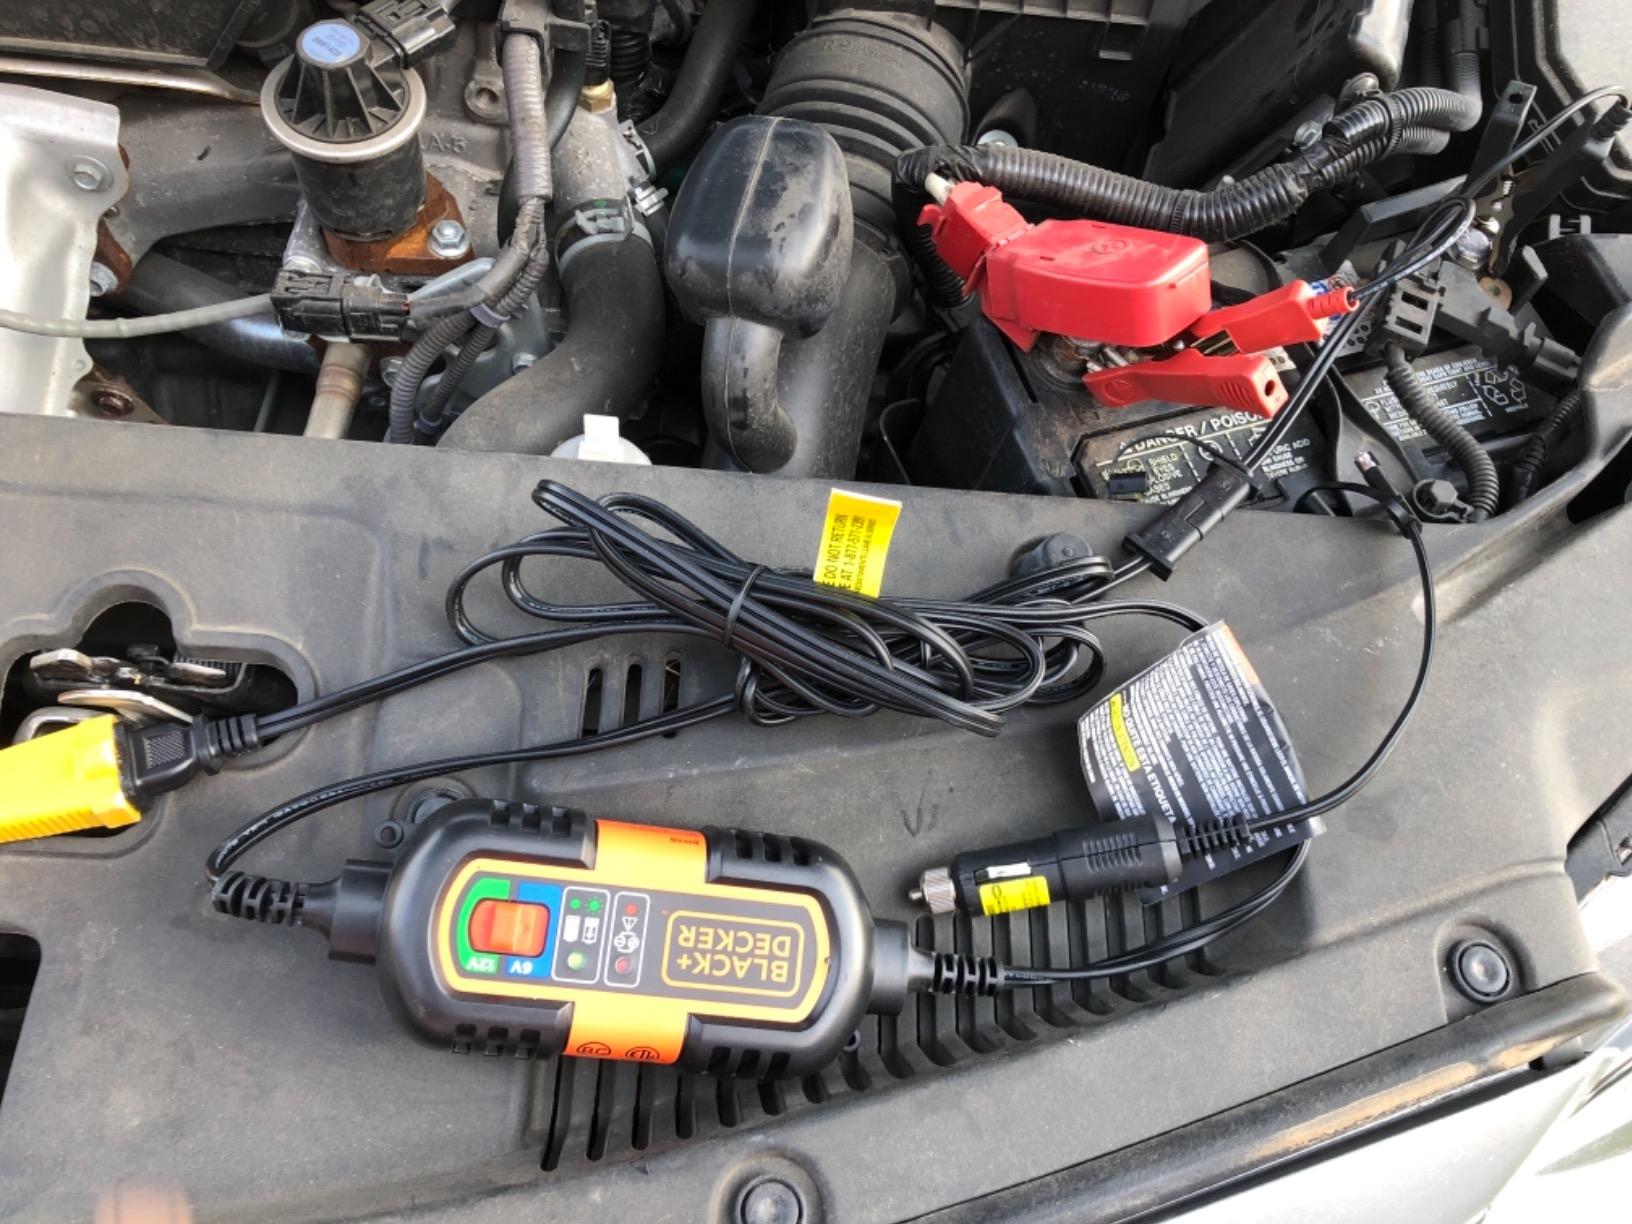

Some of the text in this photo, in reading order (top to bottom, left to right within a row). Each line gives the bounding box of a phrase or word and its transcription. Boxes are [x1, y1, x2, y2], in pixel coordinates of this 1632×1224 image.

[1209, 411, 1263, 431] POISO
[830, 513, 848, 543] RETURN
[826, 544, 841, 563] NOT
[824, 565, 838, 579] DO
[840, 569, 853, 581] AT
[1137, 747, 1153, 774] ESTA
[1146, 772, 1177, 823] ETIQUETA
[678, 925, 792, 956] DECKER
[467, 957, 533, 975] 12V 6V
[676, 952, 788, 983] BLACK+
